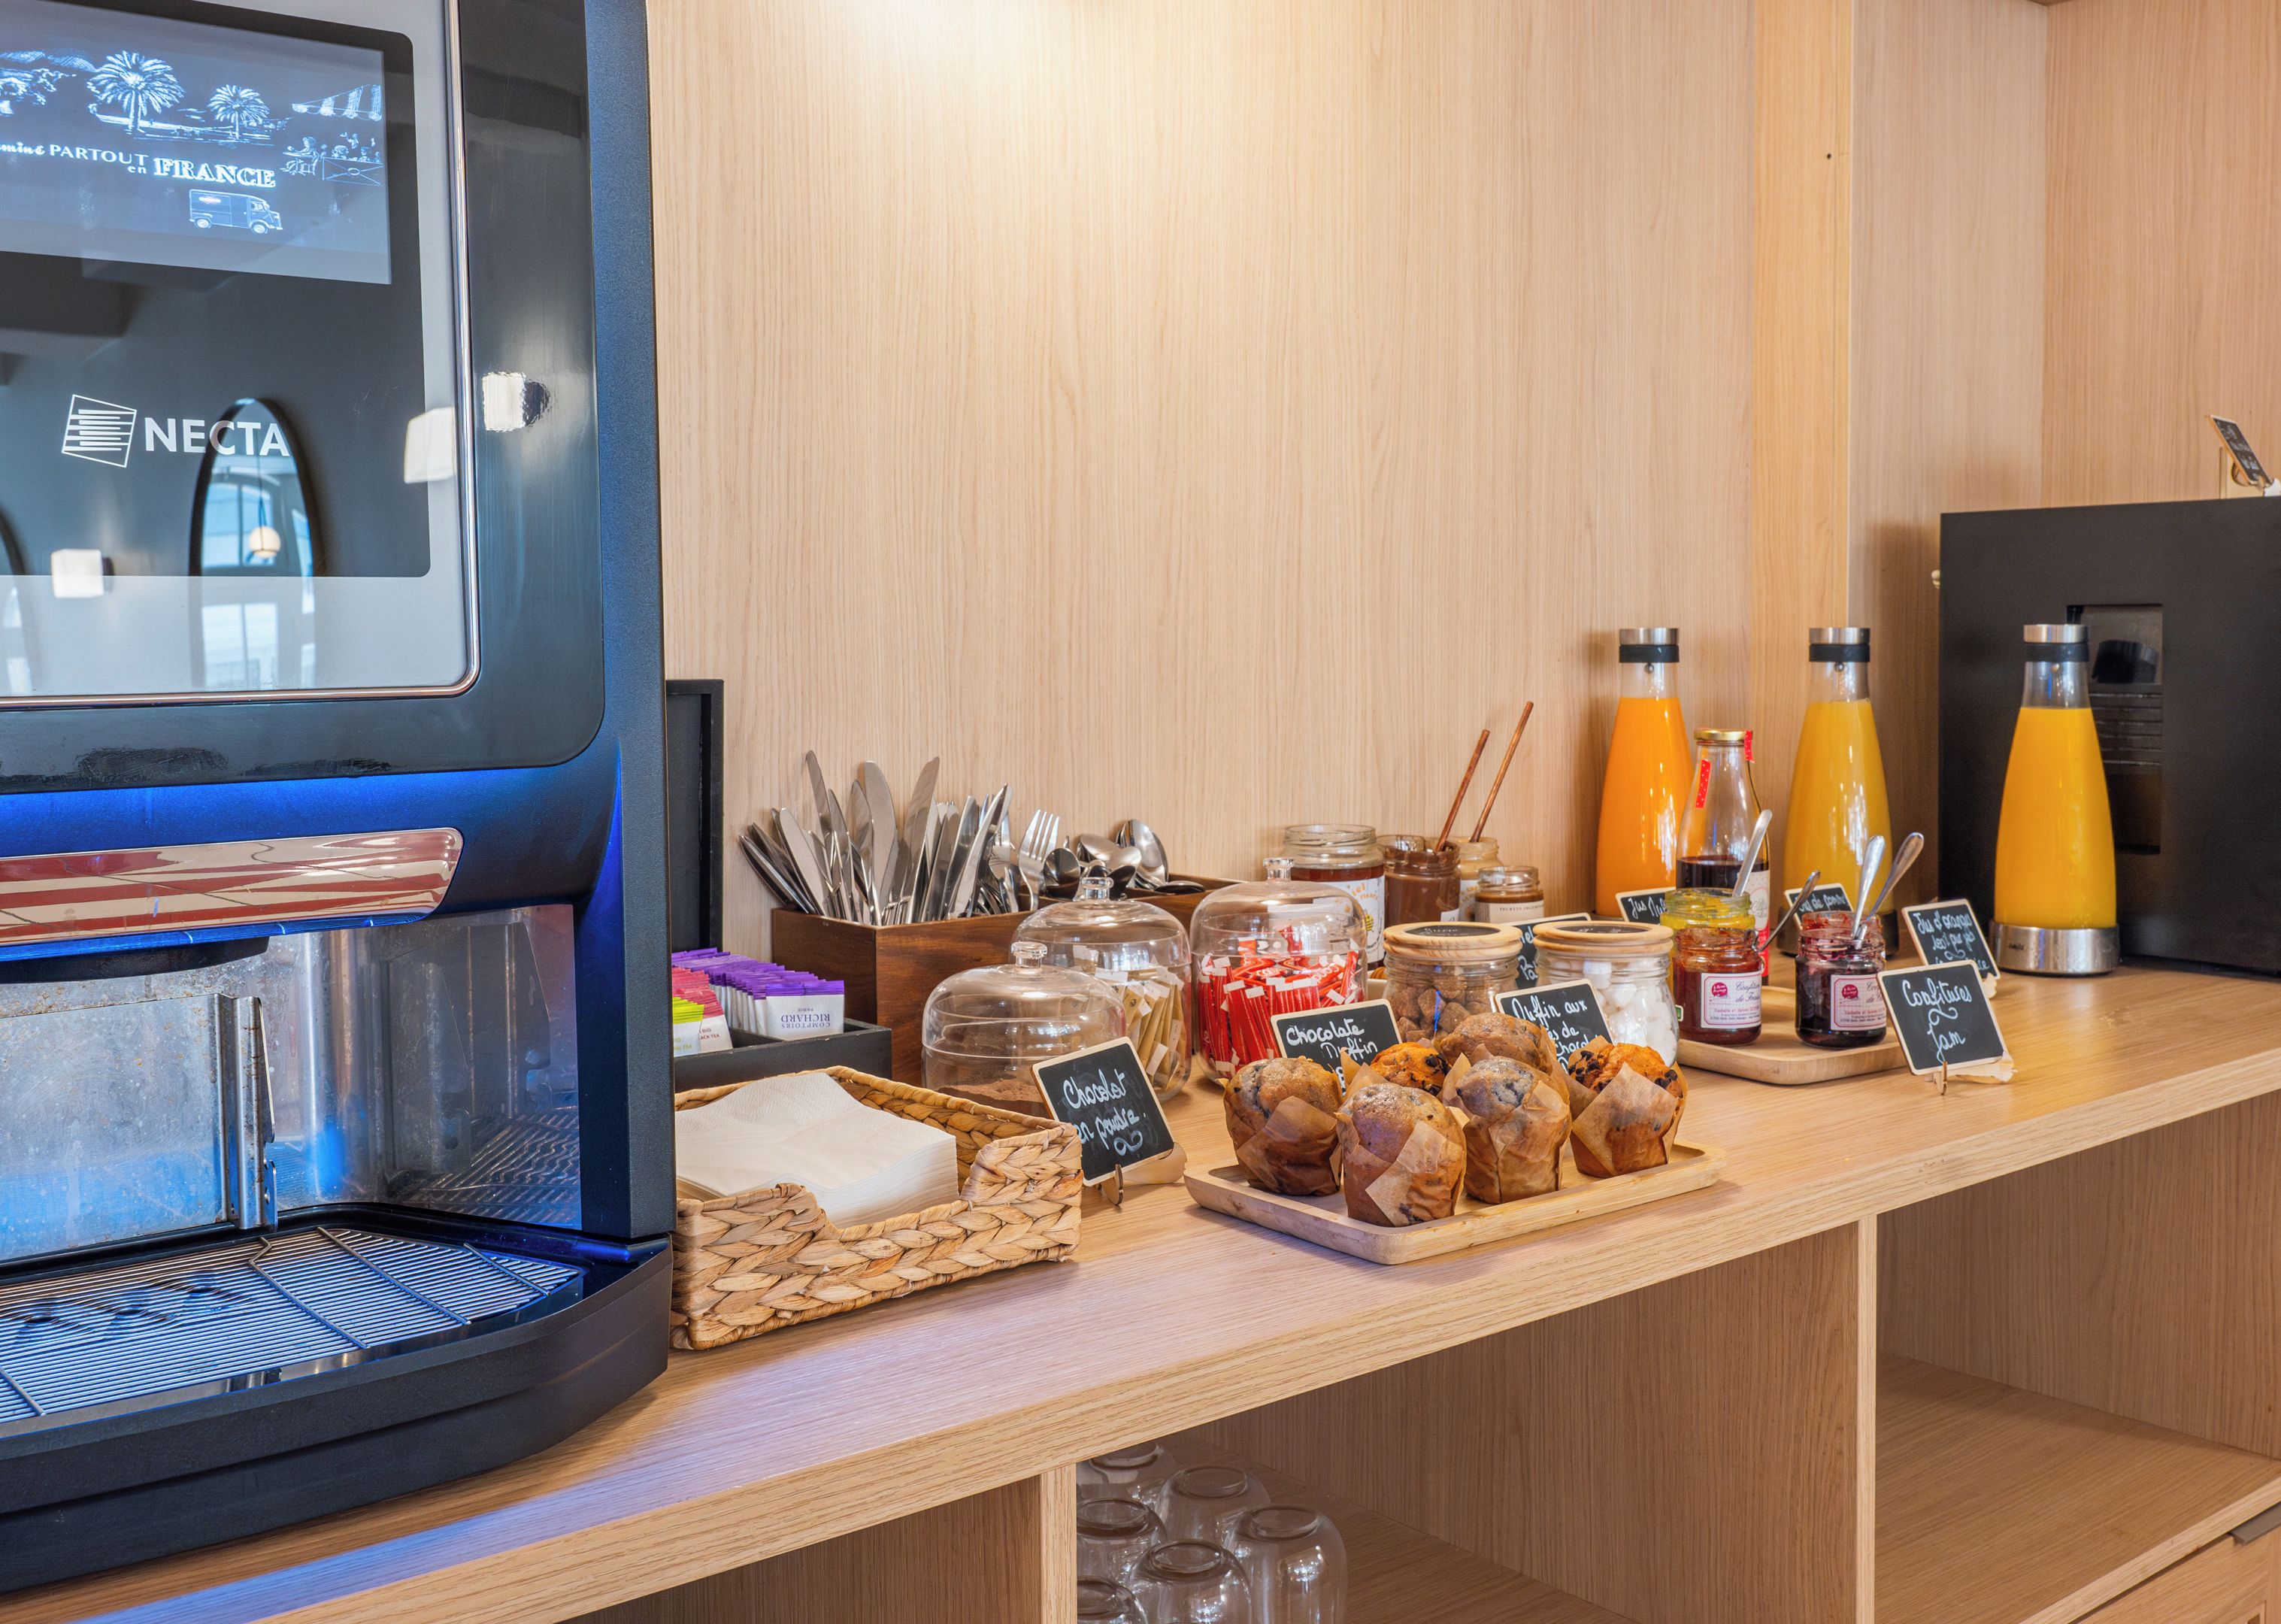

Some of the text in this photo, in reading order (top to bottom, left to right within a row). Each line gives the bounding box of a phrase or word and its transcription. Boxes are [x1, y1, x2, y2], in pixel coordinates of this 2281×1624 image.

[0, 141, 149, 166] miné PARTOUT
[127, 157, 276, 188] en FRANCE
[144, 417, 290, 456] NECTA
[1901, 977, 1972, 1008] Confitures
[781, 1013, 830, 1023] RICHARD
[1565, 999, 1588, 1014] aux
[1286, 1018, 1365, 1046] Chocolate
[1562, 1021, 1580, 1038] de
[1320, 1038, 1378, 1061] Mffin
